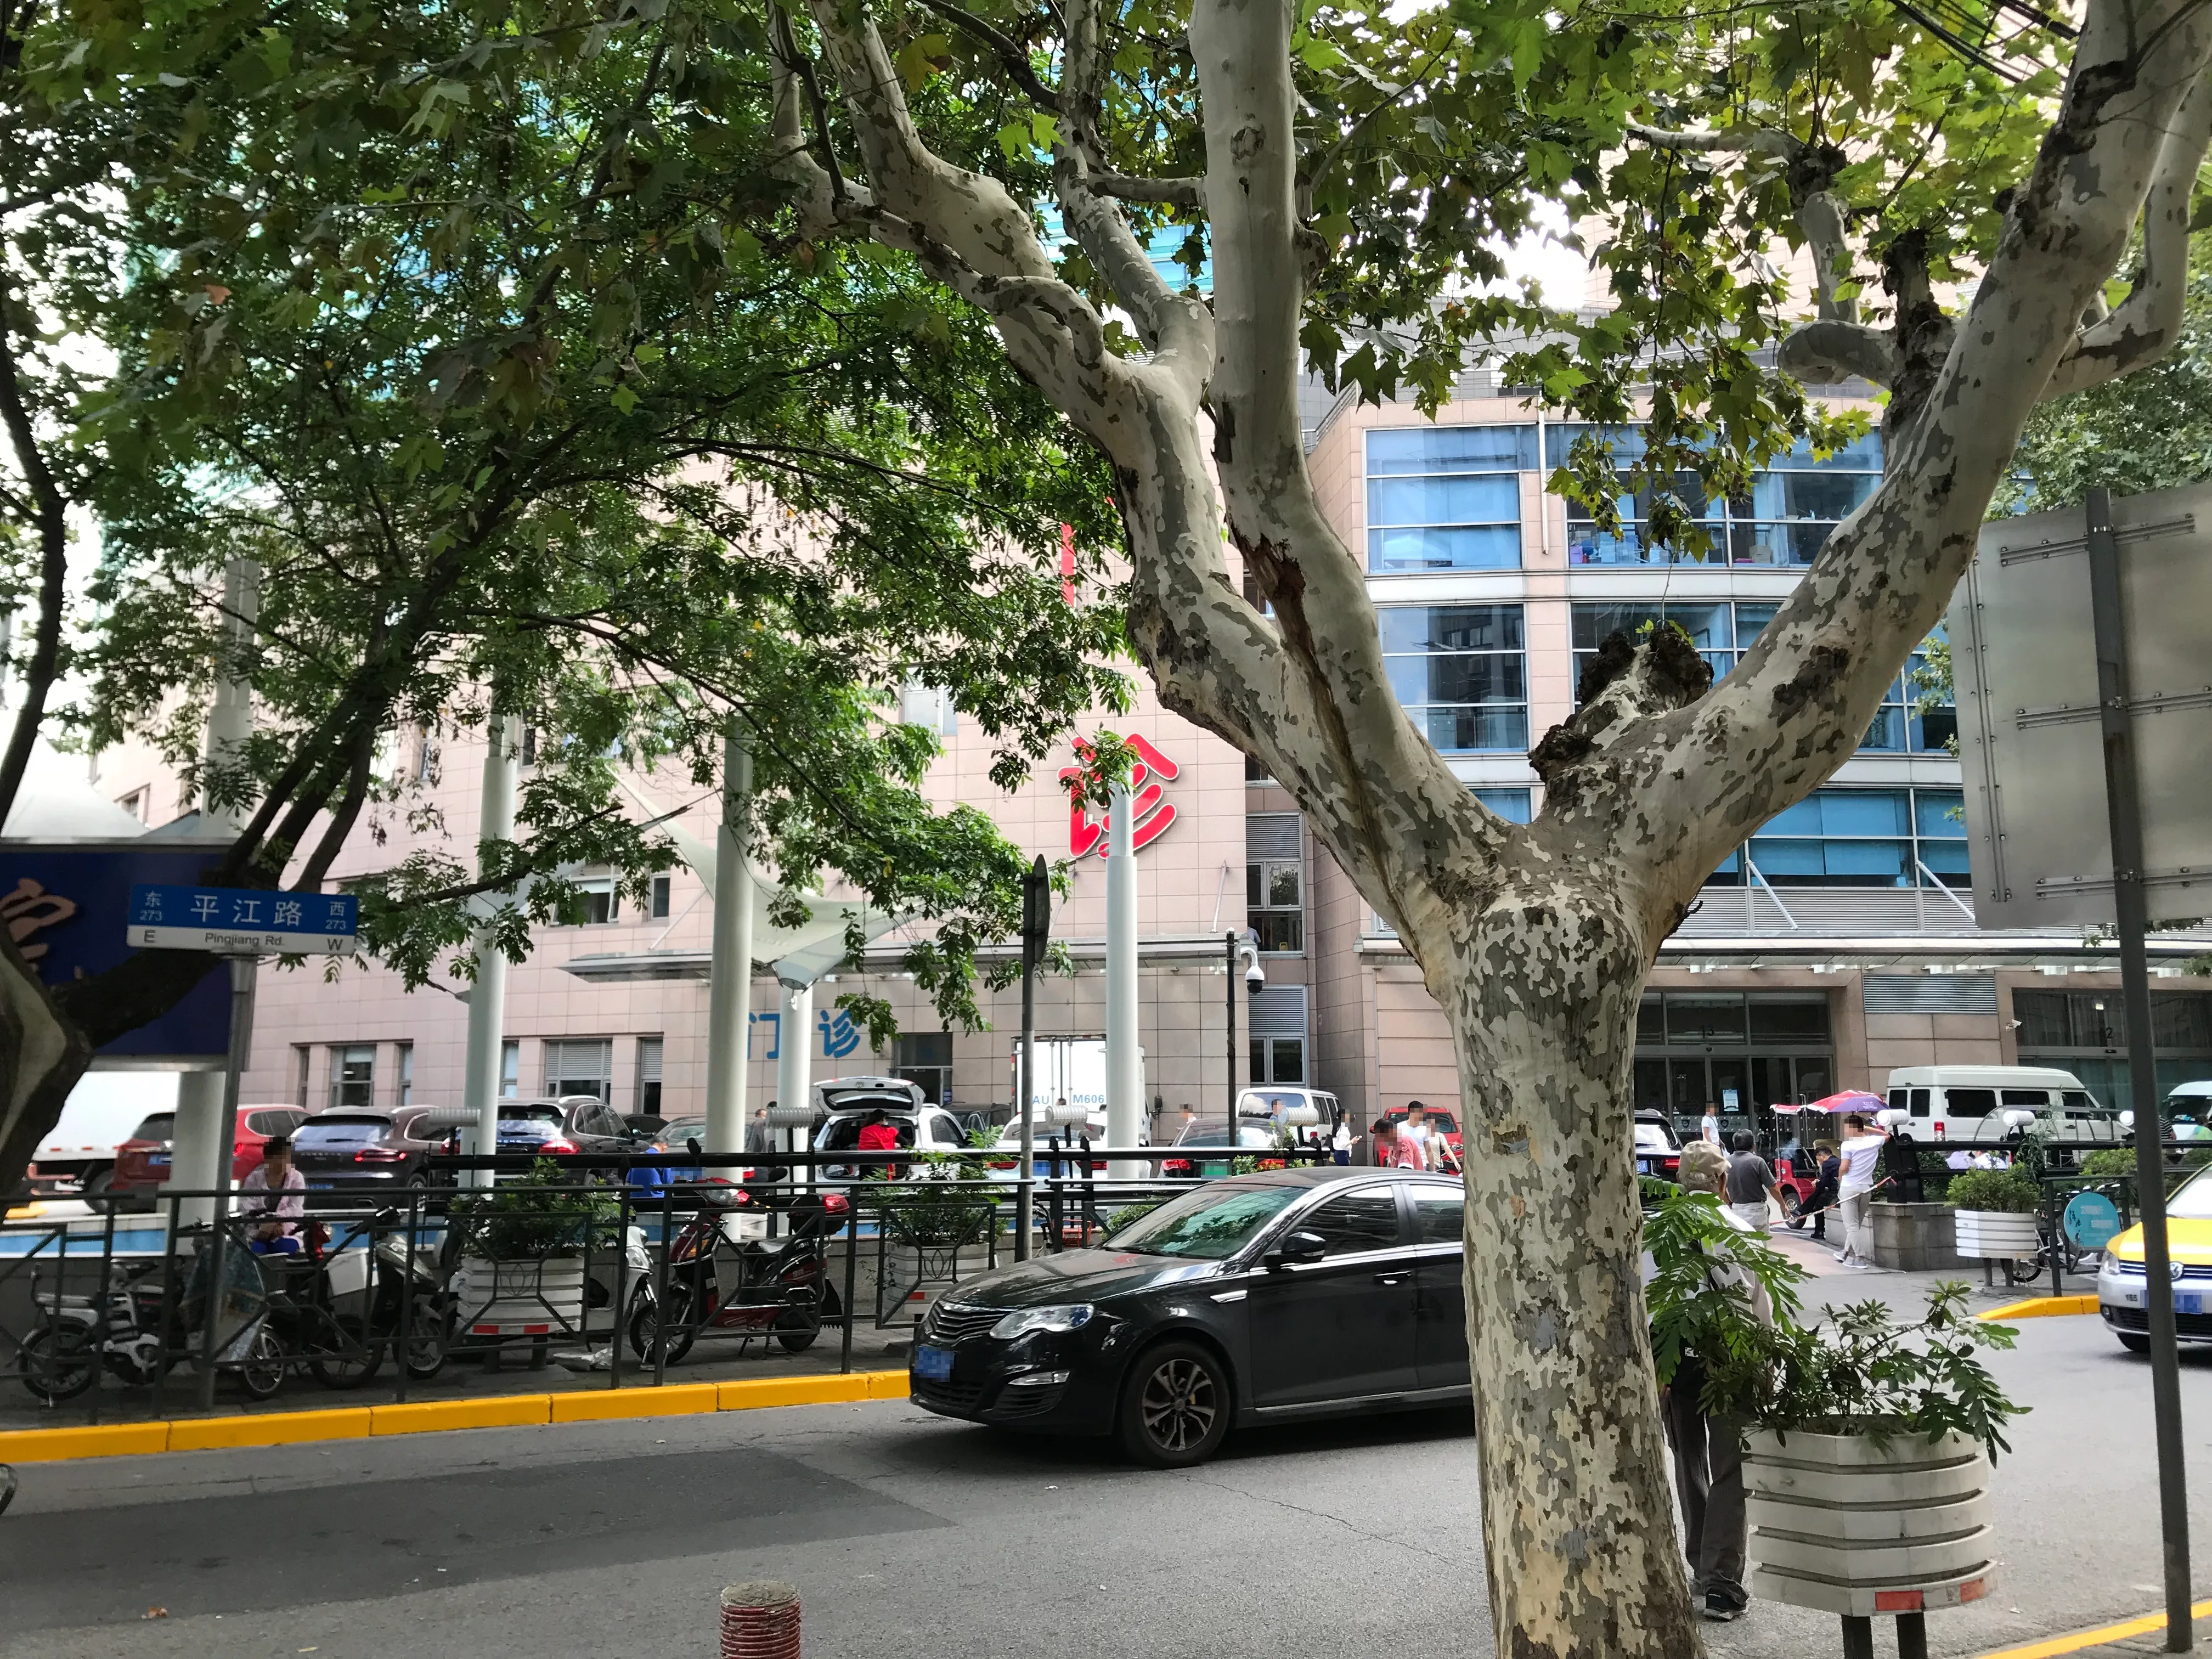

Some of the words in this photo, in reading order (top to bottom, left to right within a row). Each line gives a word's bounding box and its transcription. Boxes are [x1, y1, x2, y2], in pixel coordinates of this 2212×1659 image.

[144, 890, 162, 907] 东
[139, 910, 163, 922] 273
[190, 894, 302, 926] 平江路
[329, 901, 347, 917] 西
[325, 918, 347, 930] 273
[144, 929, 156, 944] E
[205, 933, 259, 947] Pingjiang
[327, 938, 343, 951] W
[1073, 1094, 1104, 1104] M606
